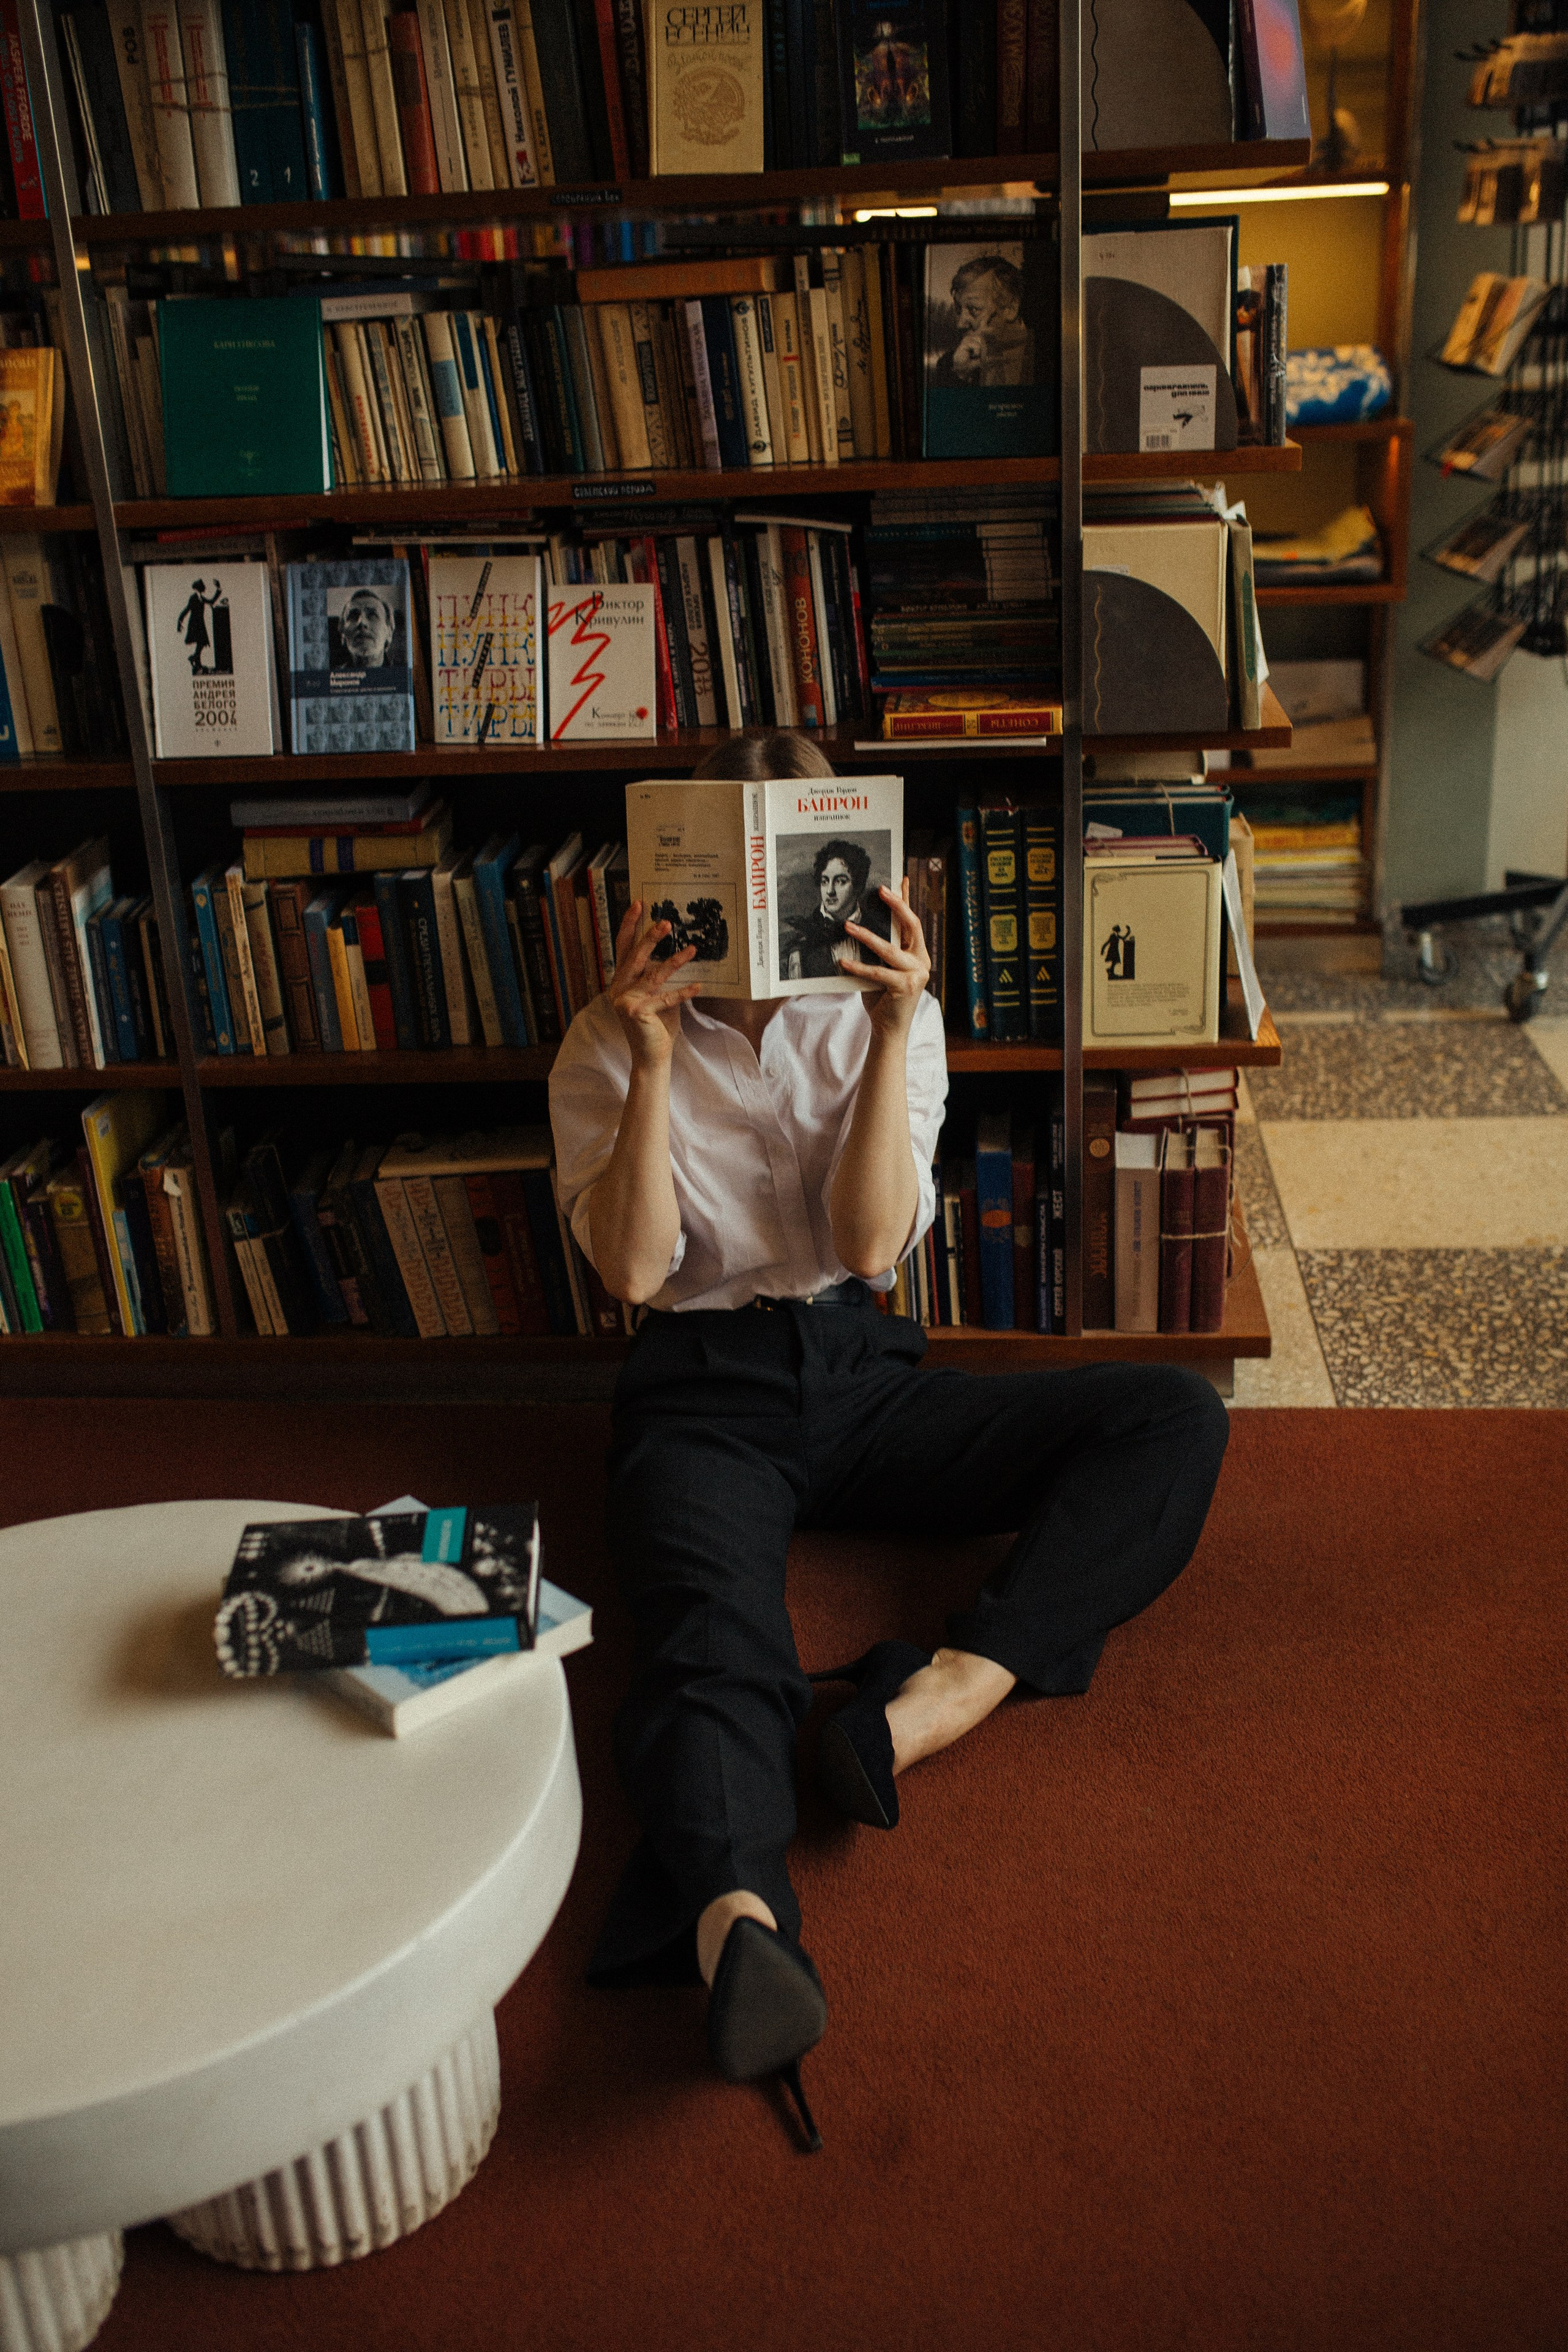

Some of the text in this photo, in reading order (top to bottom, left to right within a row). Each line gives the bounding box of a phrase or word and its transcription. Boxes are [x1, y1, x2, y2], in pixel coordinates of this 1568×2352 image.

[666, 4, 747, 26] СЕРГЕЙ
[665, 23, 751, 47] ЕСЕНИН
[8, 32, 33, 142] JASPER FFORDE
[249, 168, 260, 187] 2
[284, 166, 292, 184] 1
[753, 399, 763, 437] ДАВИД
[592, 590, 645, 612] Виктор
[576, 606, 644, 629] Кривулин
[795, 597, 813, 684] КОНОНОВ
[192, 679, 236, 689] ПРЕМИЯ
[192, 689, 236, 700] АНДРЕЯ
[193, 699, 237, 710] БЕЛОГО
[990, 717, 1039, 729] СОНЕТЫ
[797, 794, 869, 813] БАЙРОН
[750, 835, 767, 910] БАЙРОН
[1052, 1189, 1063, 1219] ЖЕСТ
